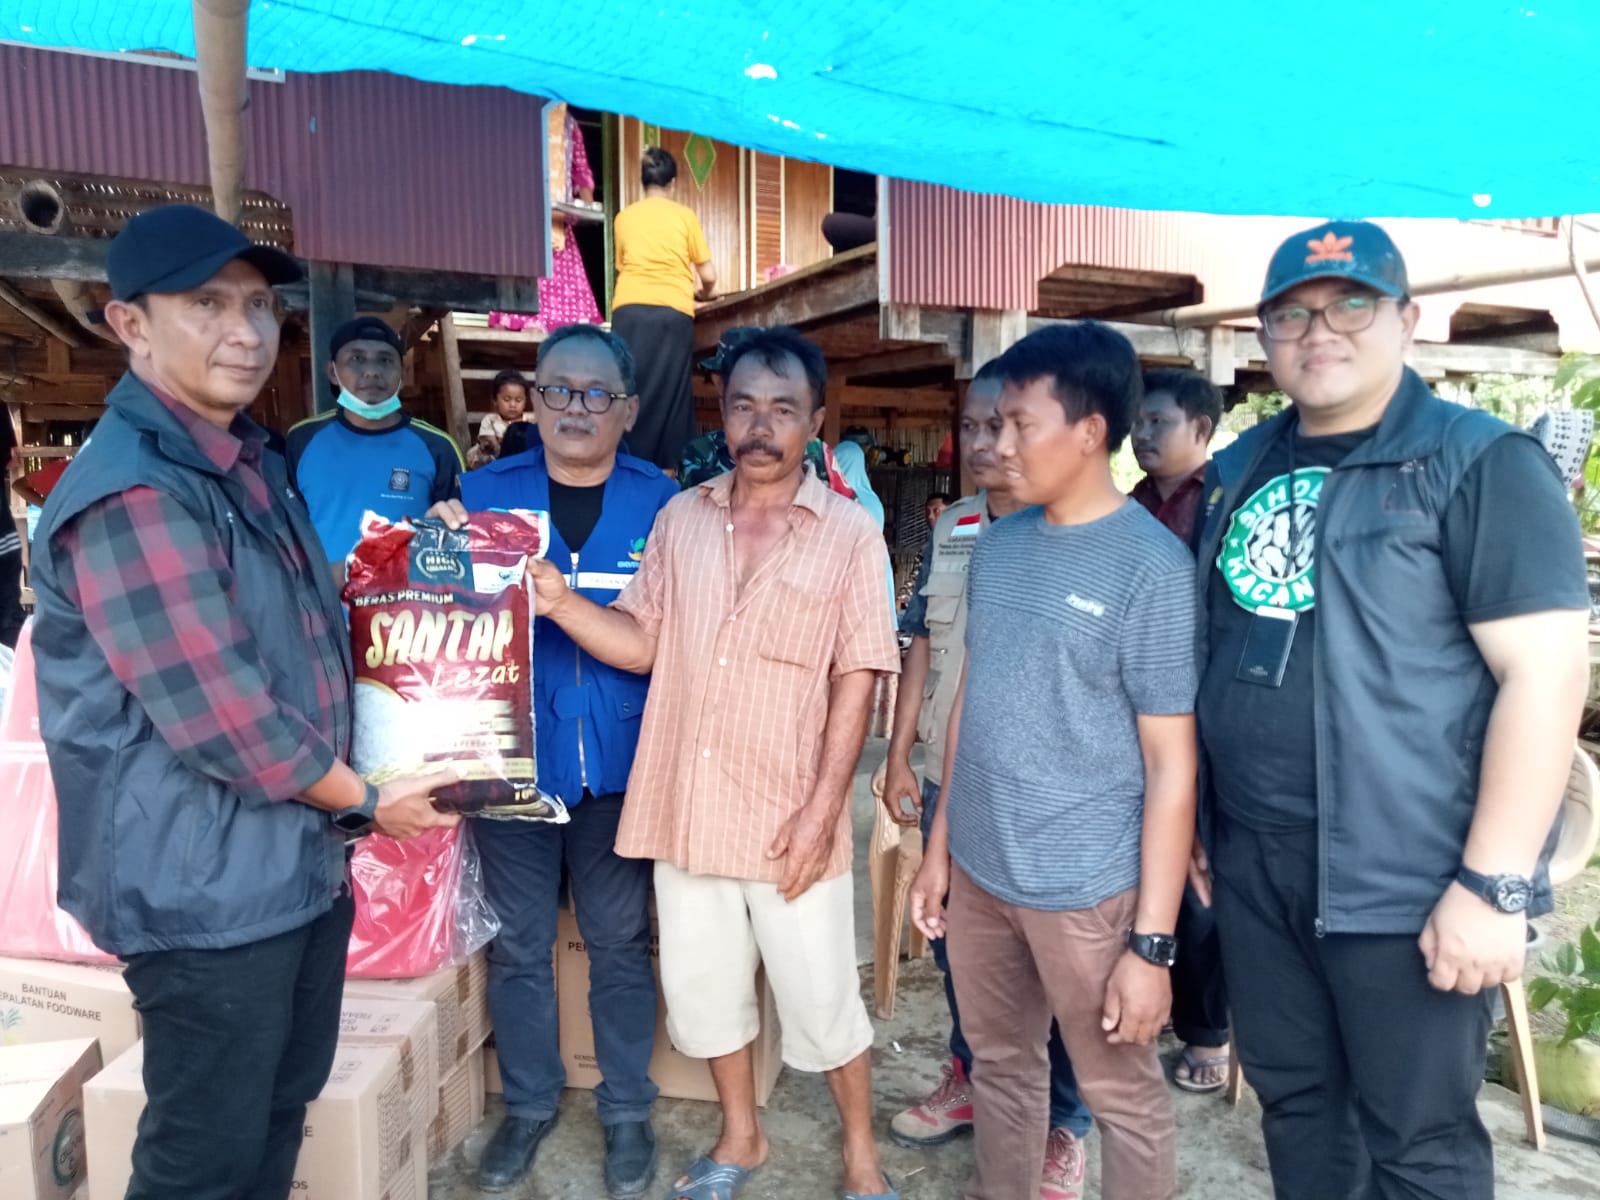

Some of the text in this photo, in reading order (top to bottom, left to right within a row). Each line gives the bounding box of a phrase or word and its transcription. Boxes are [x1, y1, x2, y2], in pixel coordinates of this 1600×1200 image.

[354, 589, 454, 607] BERAS PREMIUM
[365, 610, 513, 668] SANTAP
[22, 983, 67, 1001] BANTUAN
[47, 1001, 102, 1021] FOODWARE
